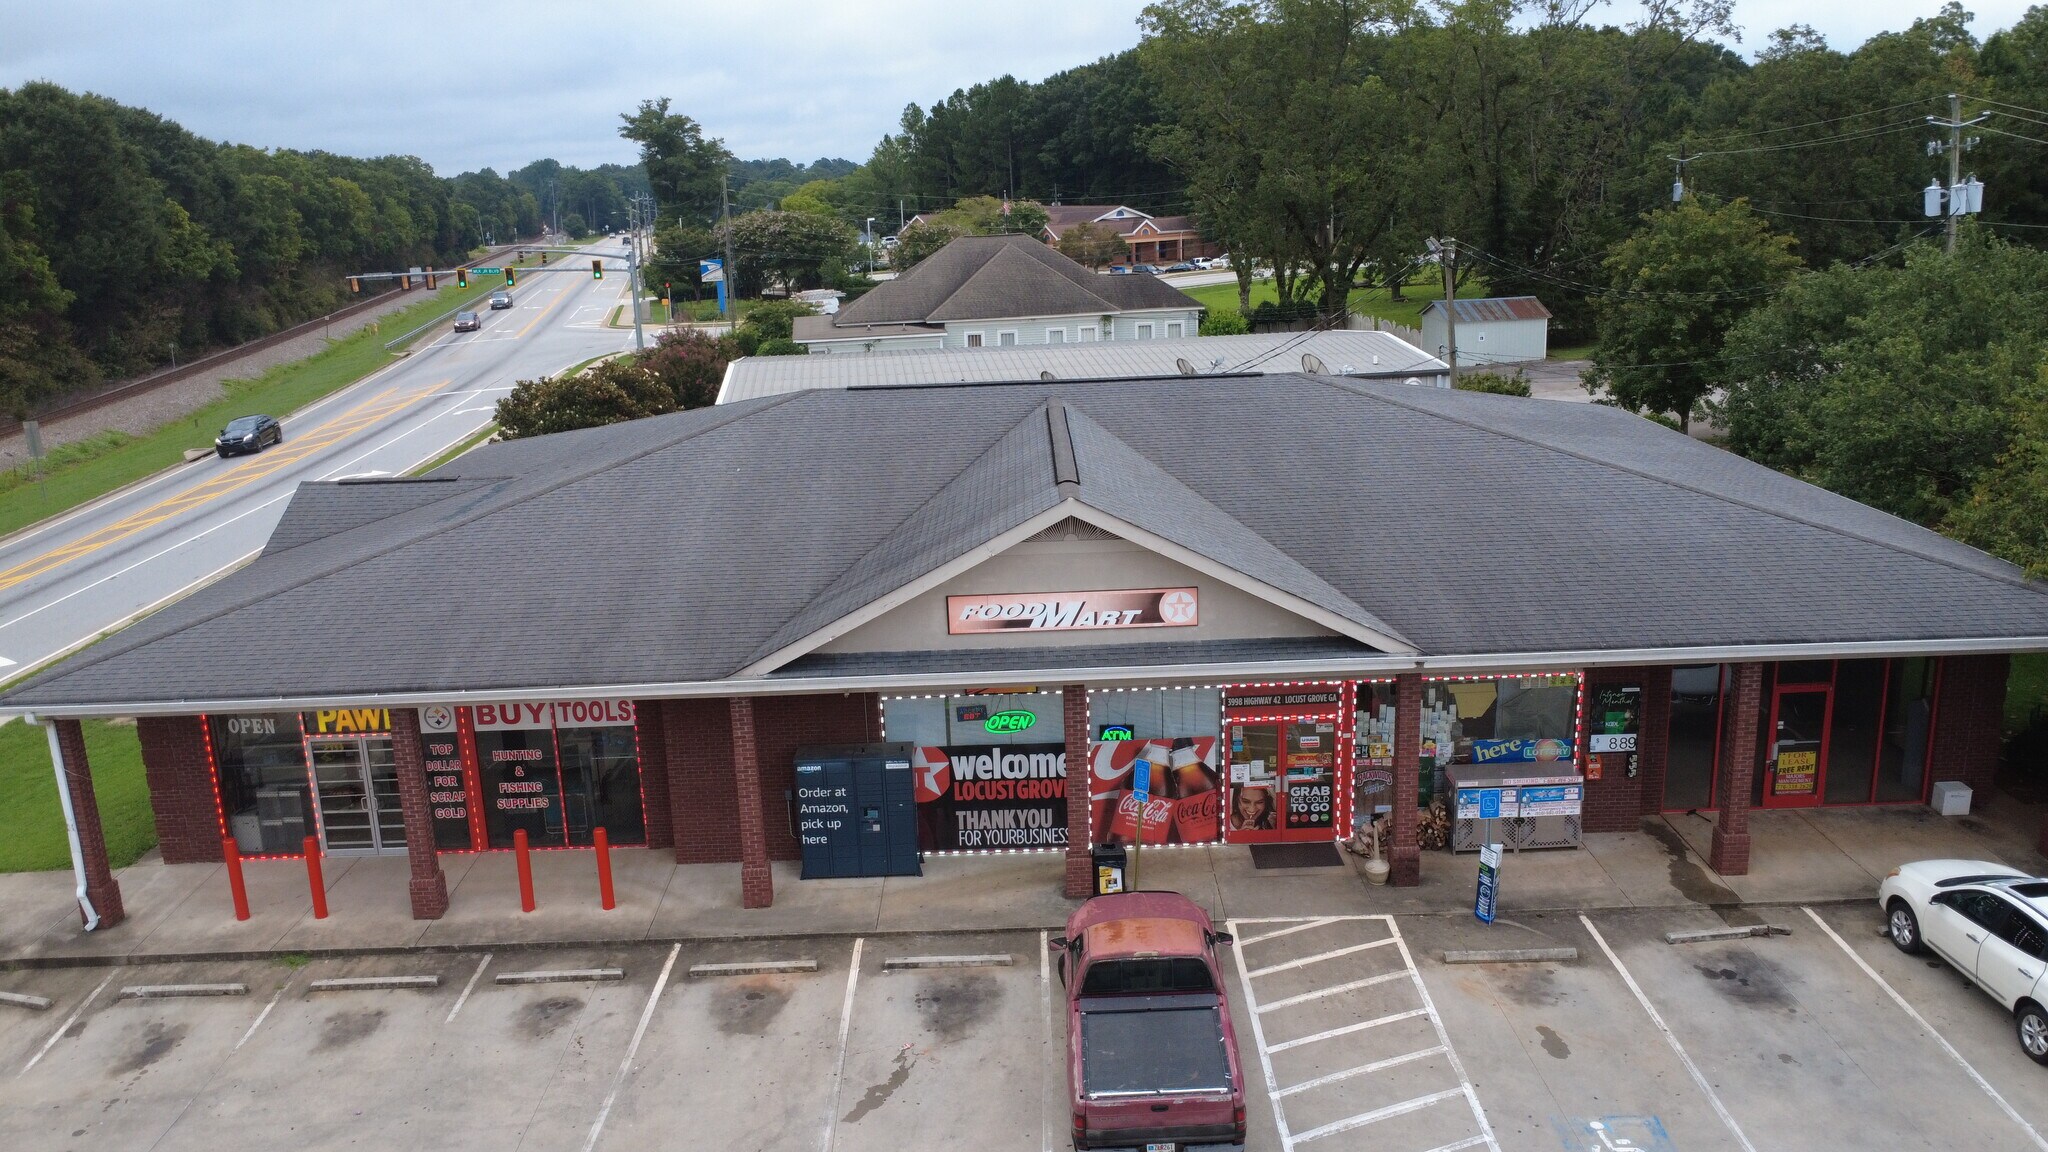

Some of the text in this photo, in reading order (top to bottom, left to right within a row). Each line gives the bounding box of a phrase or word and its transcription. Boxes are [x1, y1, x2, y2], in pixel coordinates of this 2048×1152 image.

[959, 600, 1143, 629] FOOD MART
[1227, 693, 1337, 707] 3998 HIGHWAY 42 LOCUST GROVE GA
[475, 700, 632, 726] BUY TOOLS
[227, 718, 276, 734] OPEN
[986, 715, 1031, 730] OPEN
[1101, 730, 1132, 741] ATM
[429, 744, 454, 756] TOP
[492, 748, 543, 761] HUNTING
[1474, 738, 1522, 763] here
[1526, 748, 1568, 756] LOTTERY
[425, 759, 463, 772] DOLLAR
[796, 764, 822, 773] amazon
[950, 747, 1067, 781] welcome
[514, 765, 525, 777] &
[434, 775, 458, 787] FOR
[1356, 769, 1393, 788] BACKWOODS
[498, 781, 543, 794] FISHING
[798, 787, 847, 798] Order at
[953, 780, 1016, 801] LOCUST
[1290, 785, 1331, 797] GRAB
[430, 790, 467, 803] SCRAP
[1290, 795, 1330, 804] ICE COLD
[497, 797, 550, 810] SUPPLIES
[800, 803, 849, 814] Amazon,
[1290, 802, 1330, 813] TO GO
[434, 806, 467, 819] GOLD
[801, 818, 842, 831] pick up
[802, 834, 828, 845] here
[958, 829, 982, 847] FOR
